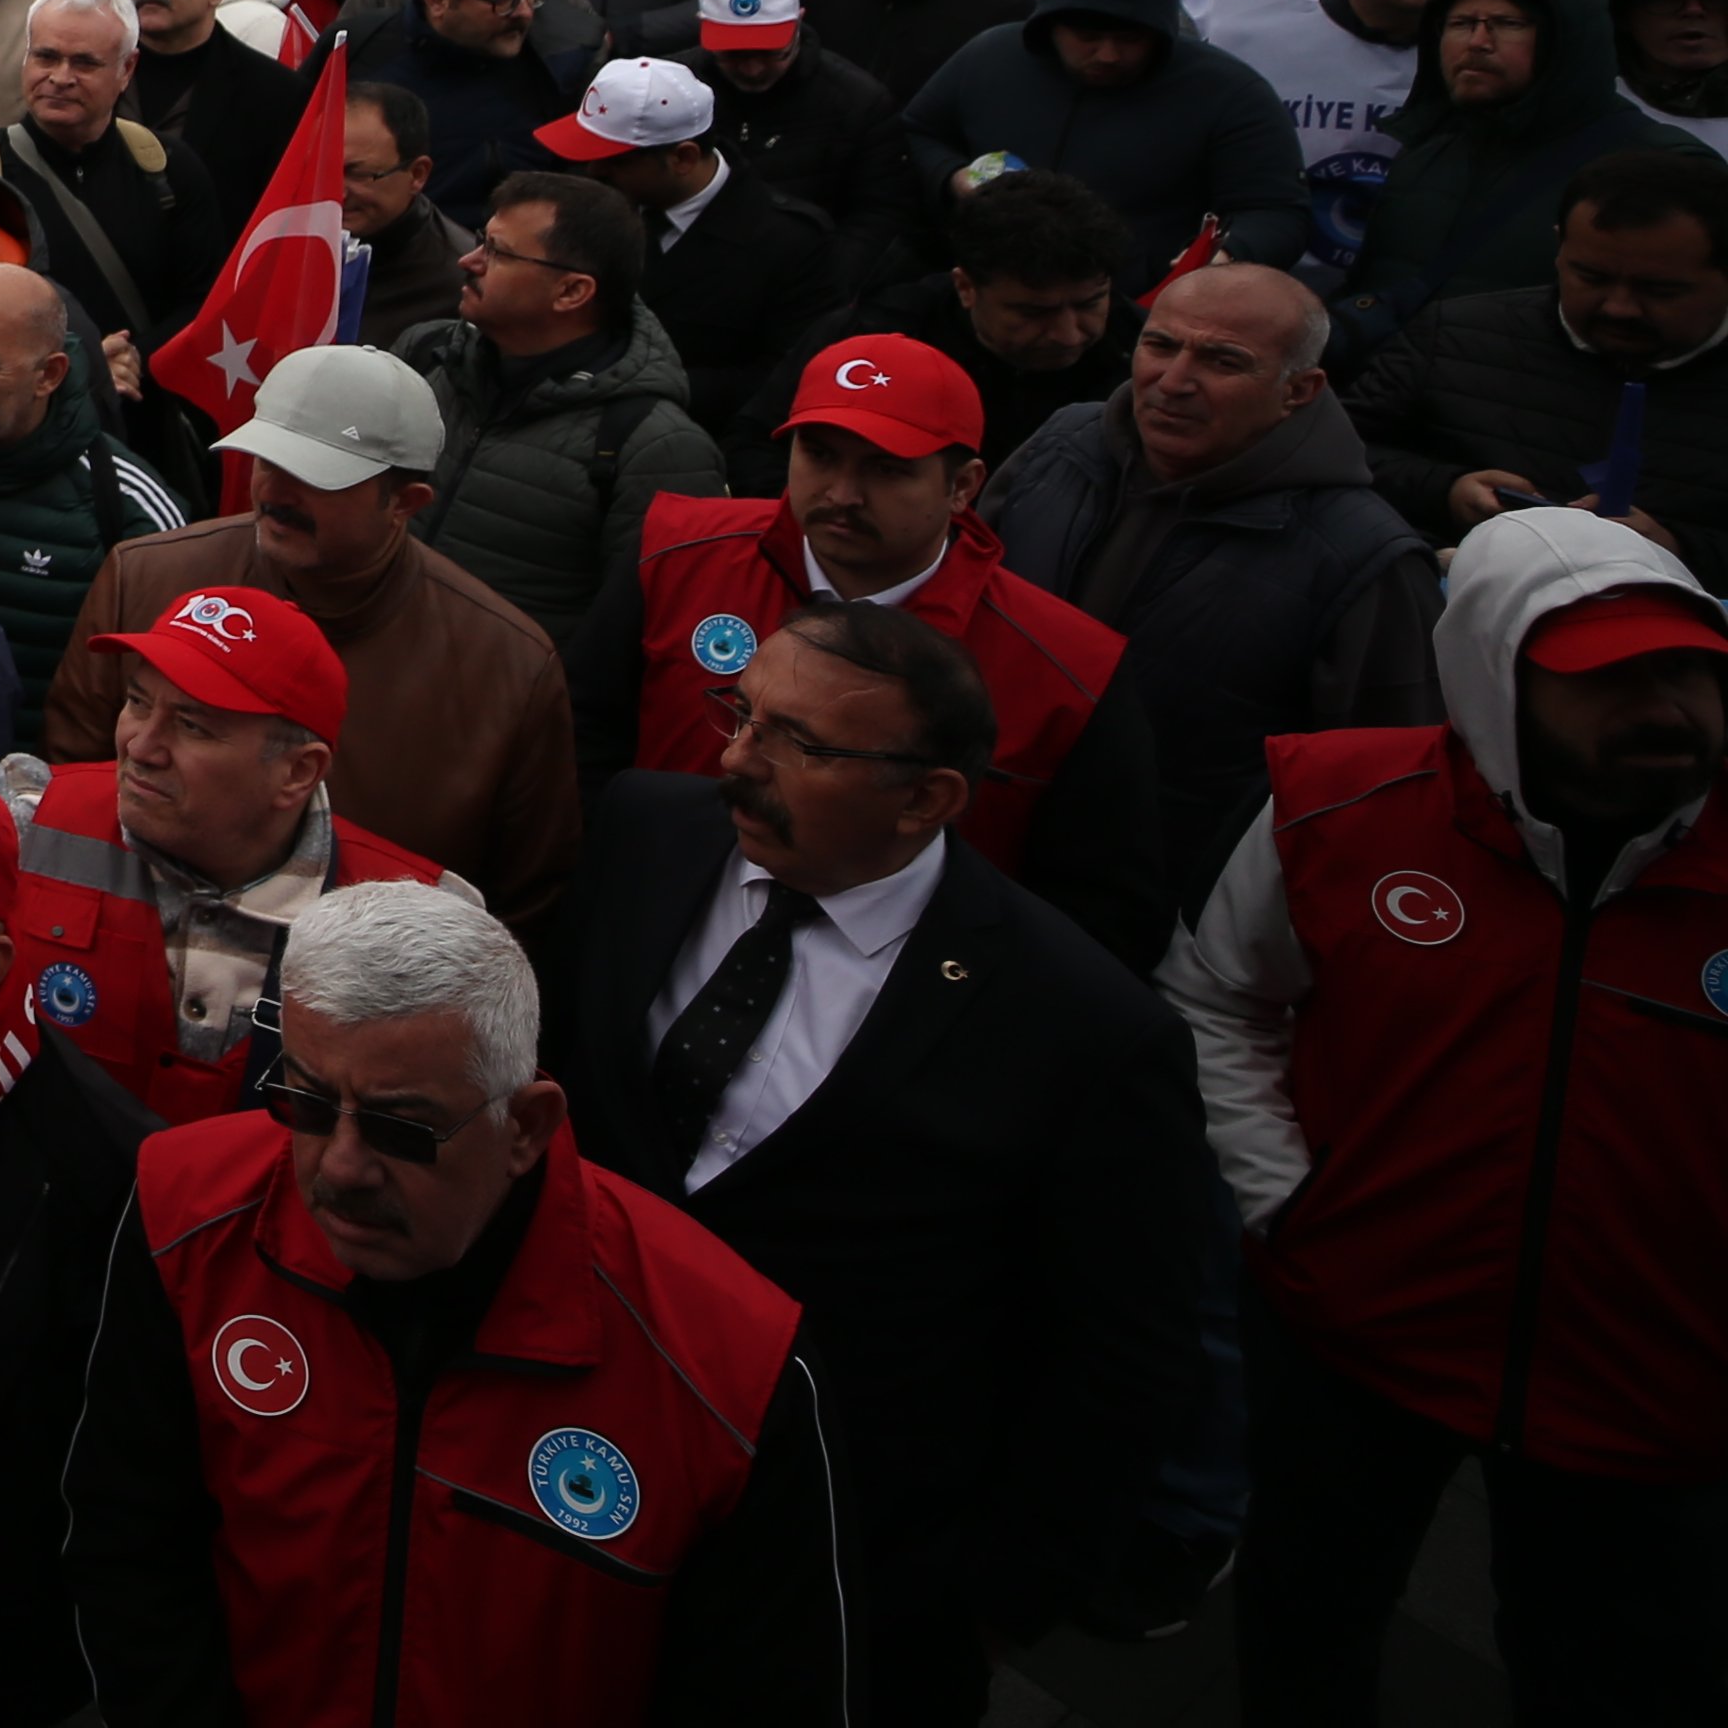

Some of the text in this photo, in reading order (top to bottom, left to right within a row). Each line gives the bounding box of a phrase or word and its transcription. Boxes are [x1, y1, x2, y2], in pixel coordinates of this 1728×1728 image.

[532, 1434, 634, 1526] TÜRKİYE KAMU-SEN
[556, 1508, 589, 1532] 1992
